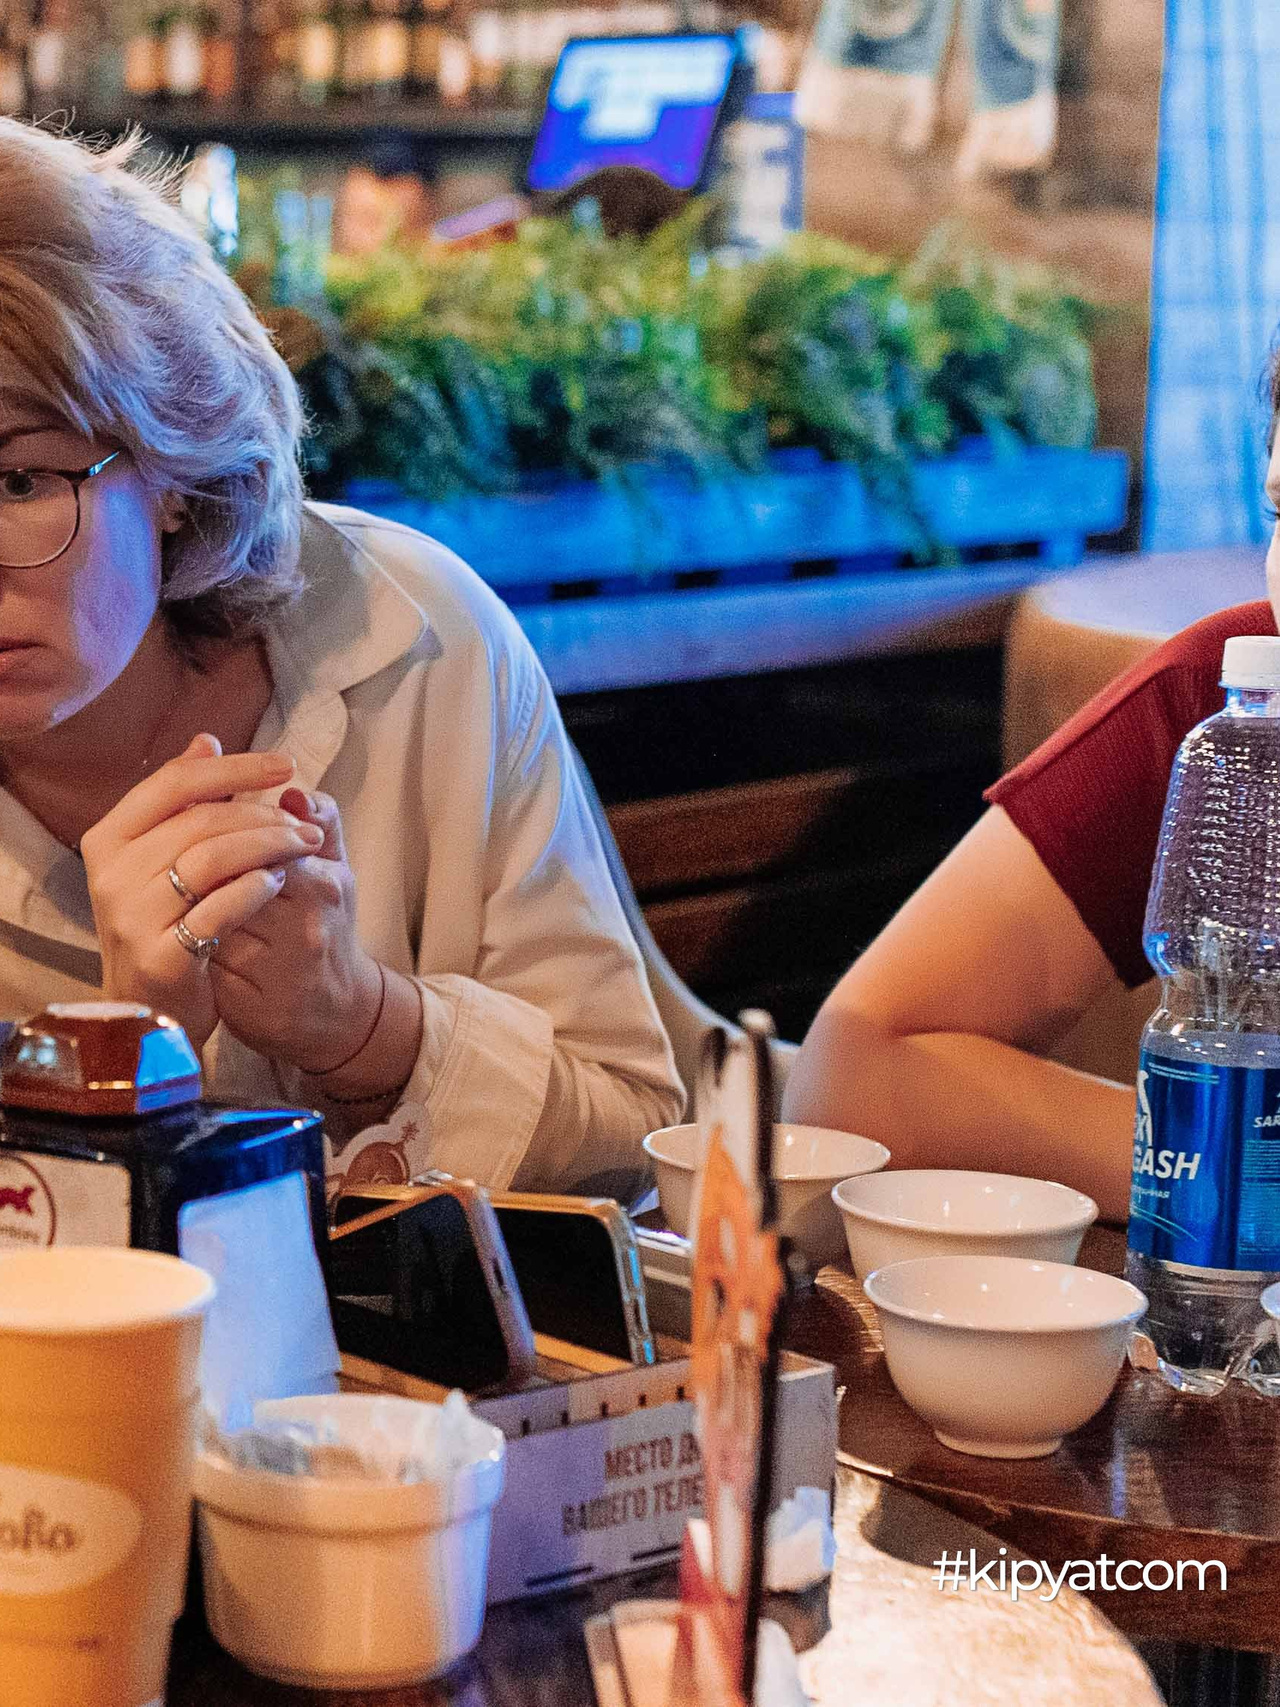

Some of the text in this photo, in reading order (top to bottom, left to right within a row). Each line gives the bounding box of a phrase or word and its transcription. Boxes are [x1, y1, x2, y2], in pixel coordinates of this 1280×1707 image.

[604, 1436, 673, 1480] МЕСТО
[561, 1473, 705, 1536] ВАШЕГО ТЕЛЕ
